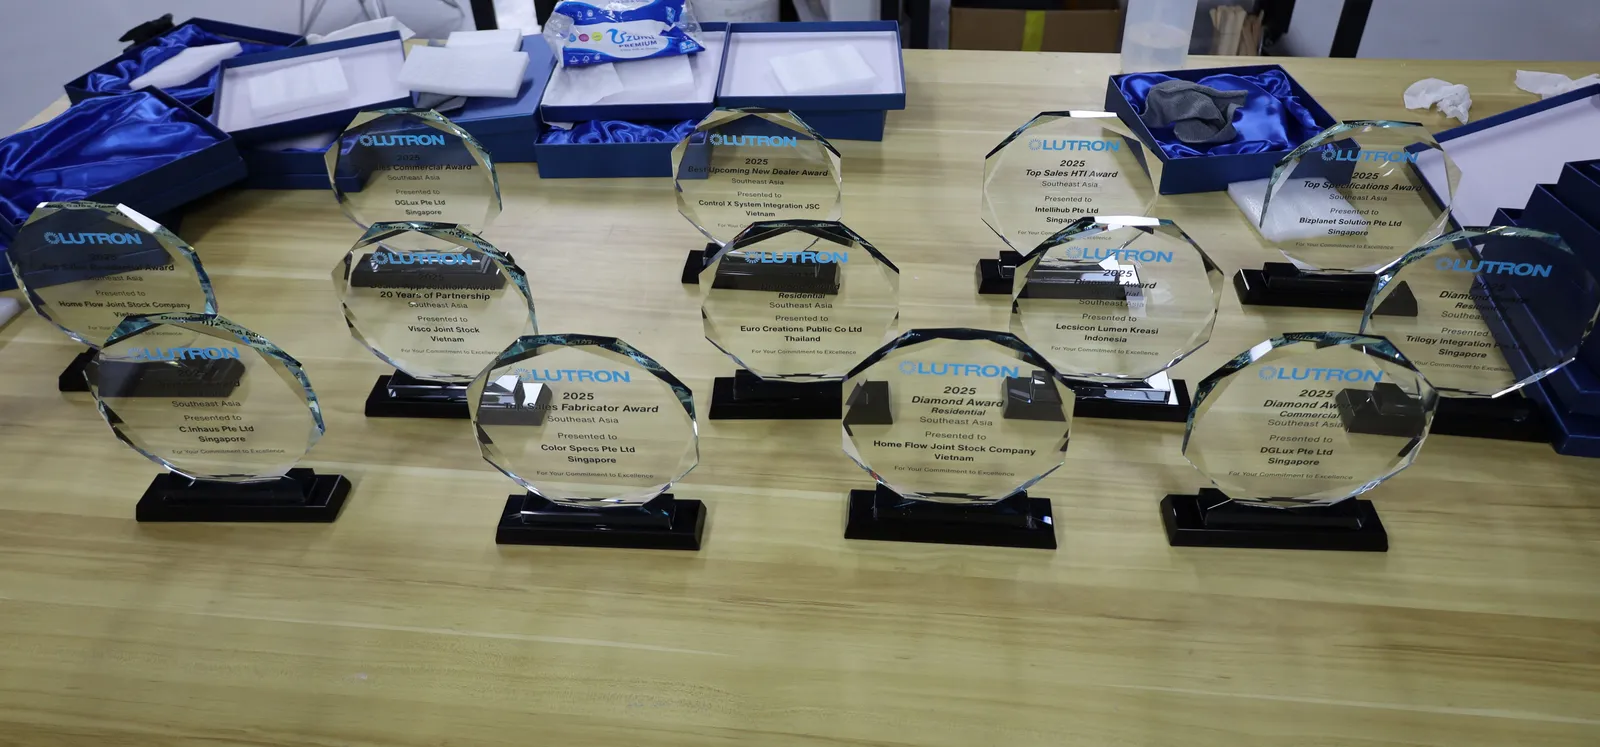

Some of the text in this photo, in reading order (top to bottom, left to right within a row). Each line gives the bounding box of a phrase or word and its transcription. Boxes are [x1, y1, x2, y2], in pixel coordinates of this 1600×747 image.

[619, 40, 657, 48] PREMIUM
[373, 135, 445, 146] LUTRON
[723, 135, 796, 147] LUTRON
[1043, 140, 1120, 152] LUTRON
[1335, 150, 1418, 163] LUTRON
[709, 167, 750, 175] Upcoming
[1026, 169, 1041, 177] Top
[1352, 172, 1379, 180] 2025
[1304, 181, 1423, 192] Top Specifications Award
[1300, 217, 1336, 225] Bizplanet
[60, 233, 142, 245] LUTRON
[388, 253, 473, 265] LUTRON
[761, 252, 848, 264] LUTRON
[1082, 248, 1172, 263] LUTRON
[1453, 260, 1552, 277] LUTRON
[1103, 269, 1133, 278] 2025
[1124, 281, 1156, 290] Award
[436, 292, 490, 301] Partnership
[1440, 291, 1489, 300] Diamond
[152, 302, 190, 310] Company
[1079, 299, 1144, 308] Southeast Asia
[1056, 324, 1095, 332] Lecsicon
[1098, 325, 1128, 333] Lumen
[1441, 328, 1488, 337] Presented
[1084, 335, 1127, 343] Indonesia
[1406, 336, 1437, 345] Trilogy
[1440, 337, 1491, 348] Integration
[149, 348, 240, 360] LUTRON
[1438, 349, 1487, 359] Singapore
[918, 362, 1018, 378] LUTRON
[532, 369, 630, 383] LUTRON
[1277, 368, 1383, 382] LUTRON
[944, 387, 976, 395] 2025
[1299, 390, 1334, 398] 2025
[563, 392, 594, 400] 2025
[172, 400, 218, 408] Southeast
[912, 396, 1004, 407] Diamond Award
[1264, 400, 1318, 408] Diamond
[504, 403, 658, 413] Top Sales Fabricator Award
[931, 407, 986, 416] Residential
[1280, 411, 1341, 419] Commercial
[548, 416, 595, 424] Southeast
[920, 416, 969, 425] Southeast
[1268, 419, 1320, 428] Southeast
[558, 432, 605, 440] Presented
[925, 431, 974, 440] Presented
[1269, 435, 1332, 443] Presented to
[569, 445, 599, 453] Specs
[958, 444, 986, 452] Stock
[989, 446, 1036, 456] Company
[1260, 447, 1294, 455] DGLux
[1317, 448, 1333, 456] Ltd
[568, 456, 616, 464] Singapore
[1268, 458, 1319, 466] Singapore
